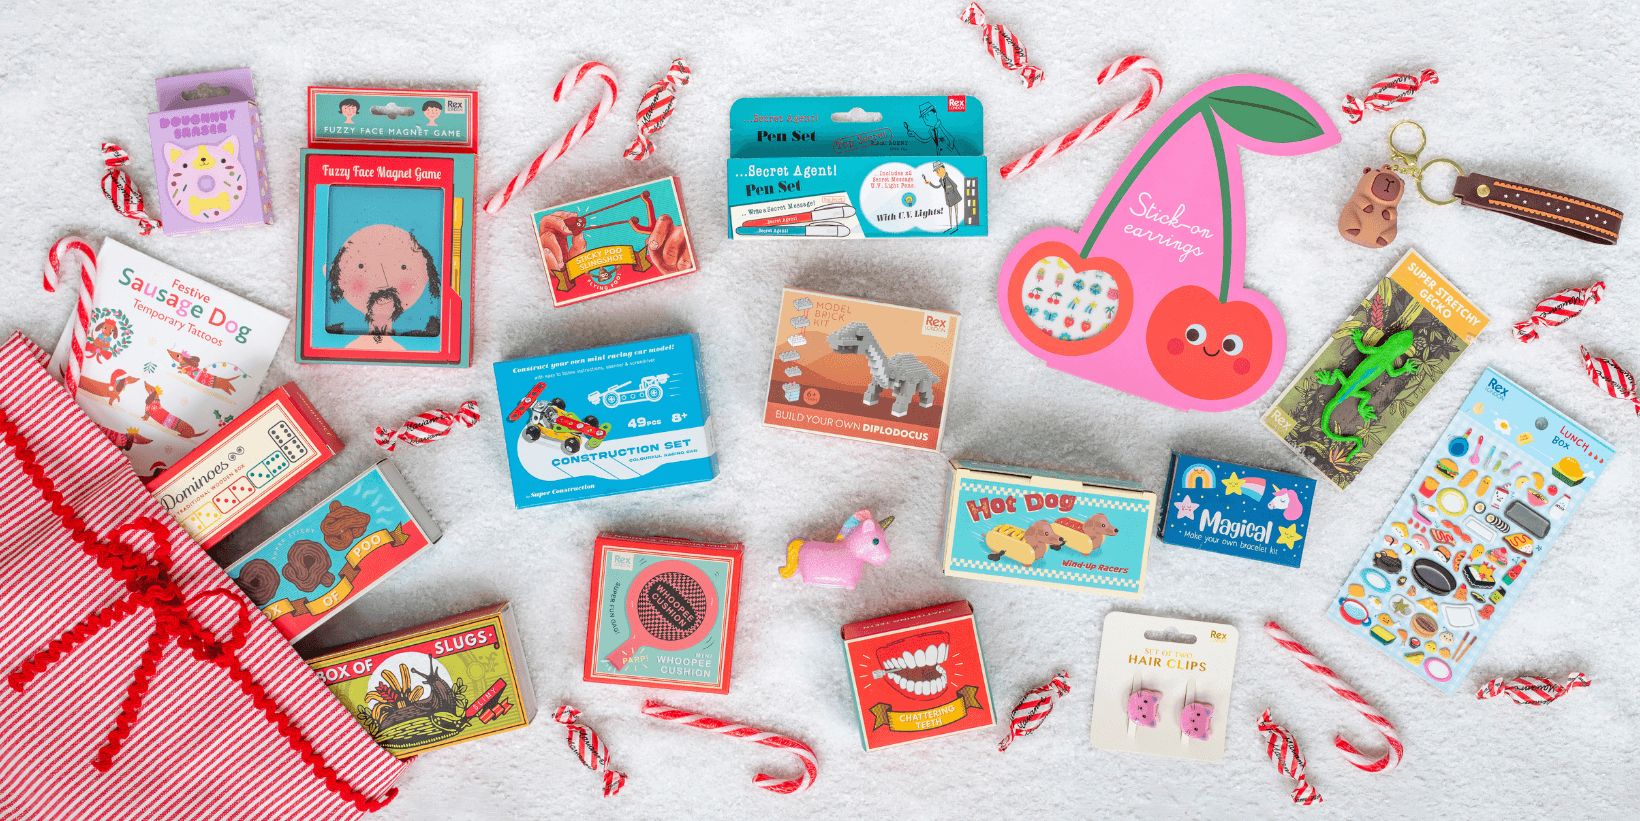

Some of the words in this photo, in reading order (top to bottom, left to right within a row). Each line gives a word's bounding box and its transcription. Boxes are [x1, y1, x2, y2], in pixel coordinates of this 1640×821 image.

[447, 100, 463, 109] Rex
[949, 98, 965, 107] Rex
[159, 109, 236, 129] DOUGHNUT
[786, 114, 819, 124] Agent!
[174, 122, 228, 139] ERASER
[324, 126, 356, 134] FUZZY
[360, 127, 384, 135] FACE
[388, 128, 429, 136] MAGNET
[433, 129, 461, 137] GAME
[757, 130, 787, 142] Pen
[791, 130, 816, 142] Set
[835, 140, 855, 149] Top
[857, 131, 888, 145] Secret
[322, 164, 350, 180] Fuzzy
[352, 165, 375, 178] Face
[376, 166, 412, 181] Magnet
[414, 167, 442, 181] Game
[793, 164, 837, 178] Agent!
[746, 184, 774, 197] Pen
[778, 180, 802, 193] Set
[876, 213, 896, 222] With
[898, 211, 913, 220] U.V.
[914, 207, 944, 219] Lights!
[1129, 192, 1214, 238] Stick-on
[1124, 224, 1204, 263] earrings
[576, 250, 603, 265] STICKY
[604, 247, 623, 257] POO
[579, 254, 623, 271] SLINGSHOT
[171, 278, 210, 304] Festive
[1407, 262, 1437, 291] SUPER
[1435, 287, 1482, 327] STRETCHY
[118, 267, 204, 319] Sausage
[208, 306, 252, 344] Dog
[816, 301, 852, 314] MODEL
[1419, 288, 1452, 319] GECKO
[132, 297, 186, 332] Temporary
[187, 322, 224, 347] Tattoos
[813, 318, 830, 327] KIT
[814, 310, 845, 322] BRICK
[925, 315, 946, 328] Rex
[512, 364, 549, 374] Construct
[550, 359, 569, 370] your
[570, 357, 586, 365] own
[587, 354, 606, 362] mini
[606, 350, 633, 360] racing
[649, 344, 675, 353] model!
[1484, 386, 1505, 401] LONDON
[1487, 377, 1509, 397] Rex
[671, 412, 688, 423] 8+
[775, 409, 805, 422] BUILD
[806, 415, 834, 427] YOUR
[835, 420, 860, 430] OWN
[862, 423, 928, 441] DIPLODOCUS
[1271, 409, 1292, 430] Rex
[1560, 426, 1590, 453] LUNCH
[551, 444, 660, 467] CONSTRUCTION
[664, 438, 691, 450] SET
[628, 454, 662, 463] COLOURFUL
[160, 461, 229, 512] Dominoes
[177, 490, 211, 515] TRADITIONAL
[211, 472, 234, 490] WOODEN
[234, 464, 246, 473] BOX
[530, 491, 551, 499] Super
[552, 484, 595, 495] Construction
[966, 495, 1017, 523] Hot
[1024, 493, 1076, 512] Dog
[288, 528, 316, 538] STICKY
[1199, 508, 1273, 545] Magical
[1184, 530, 1202, 541] Make
[1204, 534, 1220, 544] your
[1222, 539, 1238, 547] own
[1240, 541, 1267, 554] bracelet
[1269, 546, 1278, 556] kit
[614, 555, 631, 564] Rex
[1061, 560, 1097, 571] Wind-Up
[1097, 564, 1129, 574] Racers
[264, 604, 282, 620] OX
[322, 591, 340, 606] OF
[353, 534, 381, 558] POO
[610, 581, 621, 603] SUPER
[651, 592, 687, 628] CUSHION
[656, 584, 695, 623] WHOOPEE
[1210, 630, 1227, 640] Rex
[622, 655, 649, 665] PARP!
[656, 655, 712, 668] WHOOPEE
[1128, 654, 1162, 667] HAIR
[1166, 659, 1207, 672] CLIPS
[1161, 649, 1173, 657] OF
[1174, 651, 1193, 659] TWO
[316, 666, 349, 684] BOX
[353, 658, 373, 675] OF
[660, 666, 711, 678] CUSHION
[472, 687, 498, 711] SLIMY
[899, 704, 955, 722] CHATTERING
[916, 718, 943, 729] TEETH
